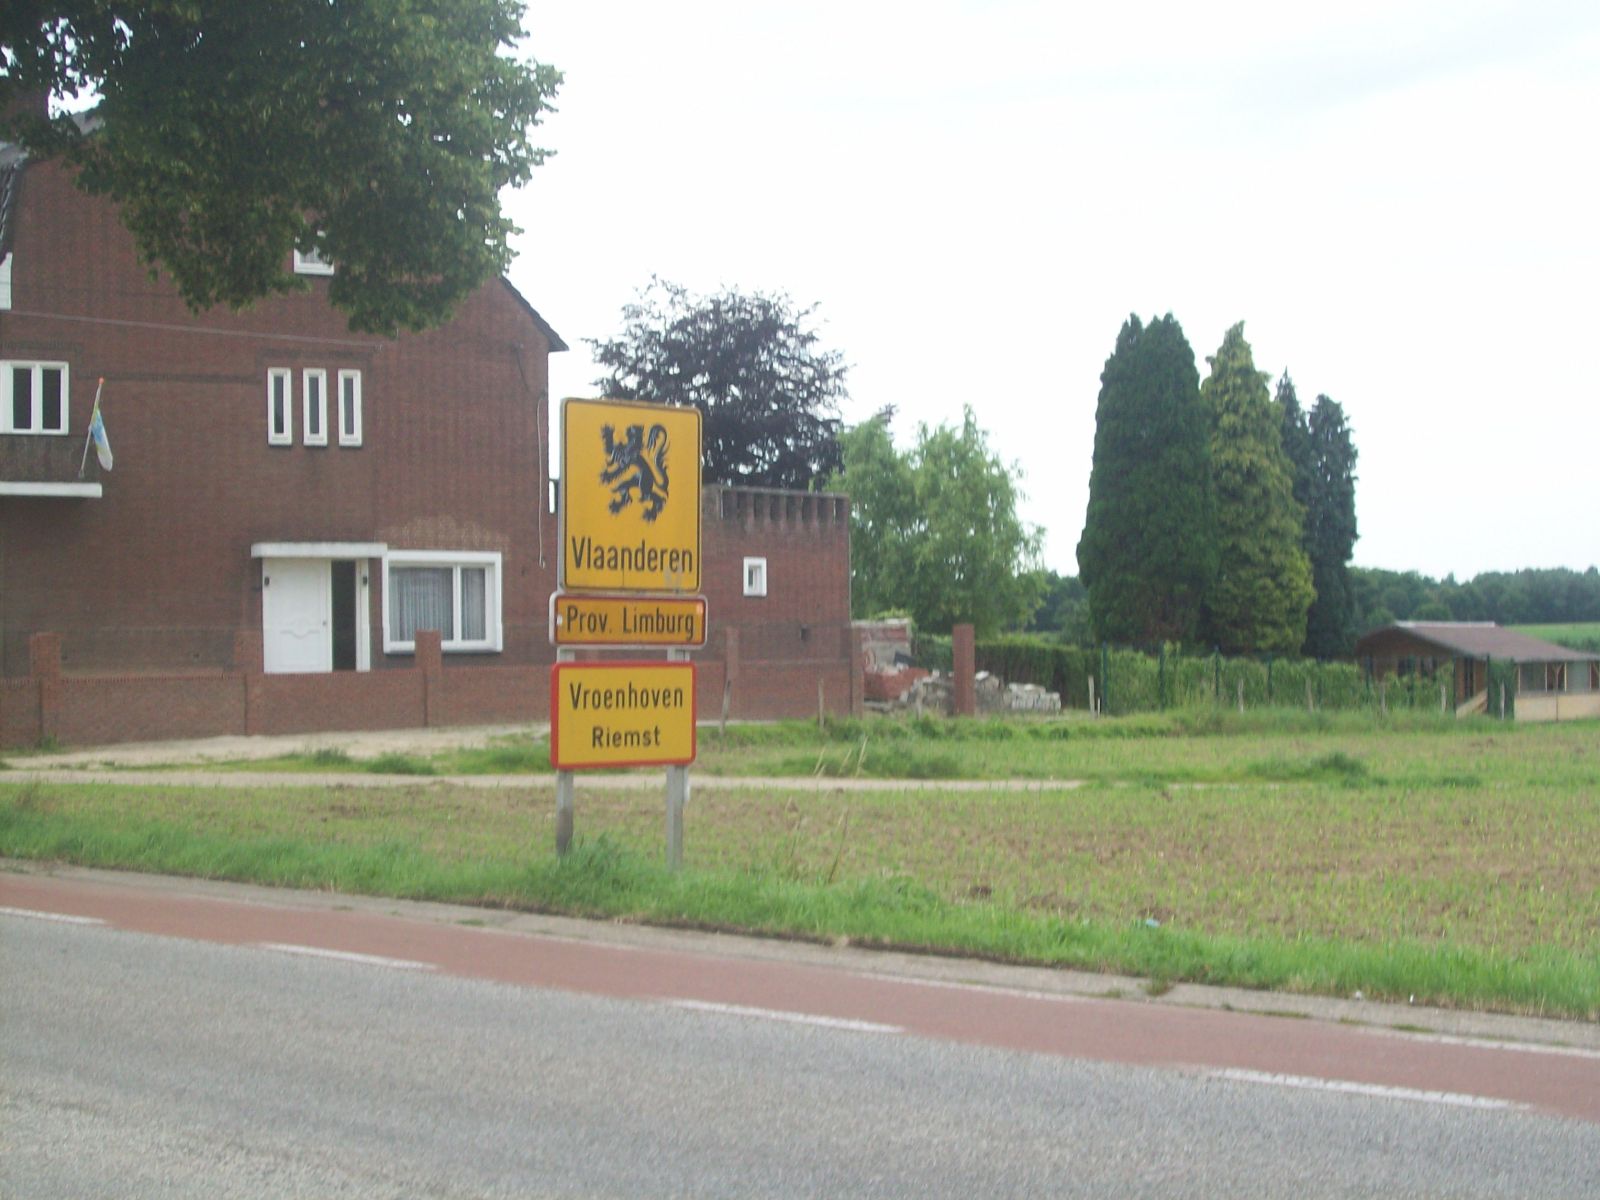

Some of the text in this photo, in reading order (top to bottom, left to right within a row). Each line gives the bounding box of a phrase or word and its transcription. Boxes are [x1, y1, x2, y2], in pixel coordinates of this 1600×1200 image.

[572, 536, 693, 573] Vlaanderen
[566, 605, 695, 641] Prov. Limburg
[569, 682, 684, 710] Vroenhoven
[592, 726, 661, 749] Riemst
